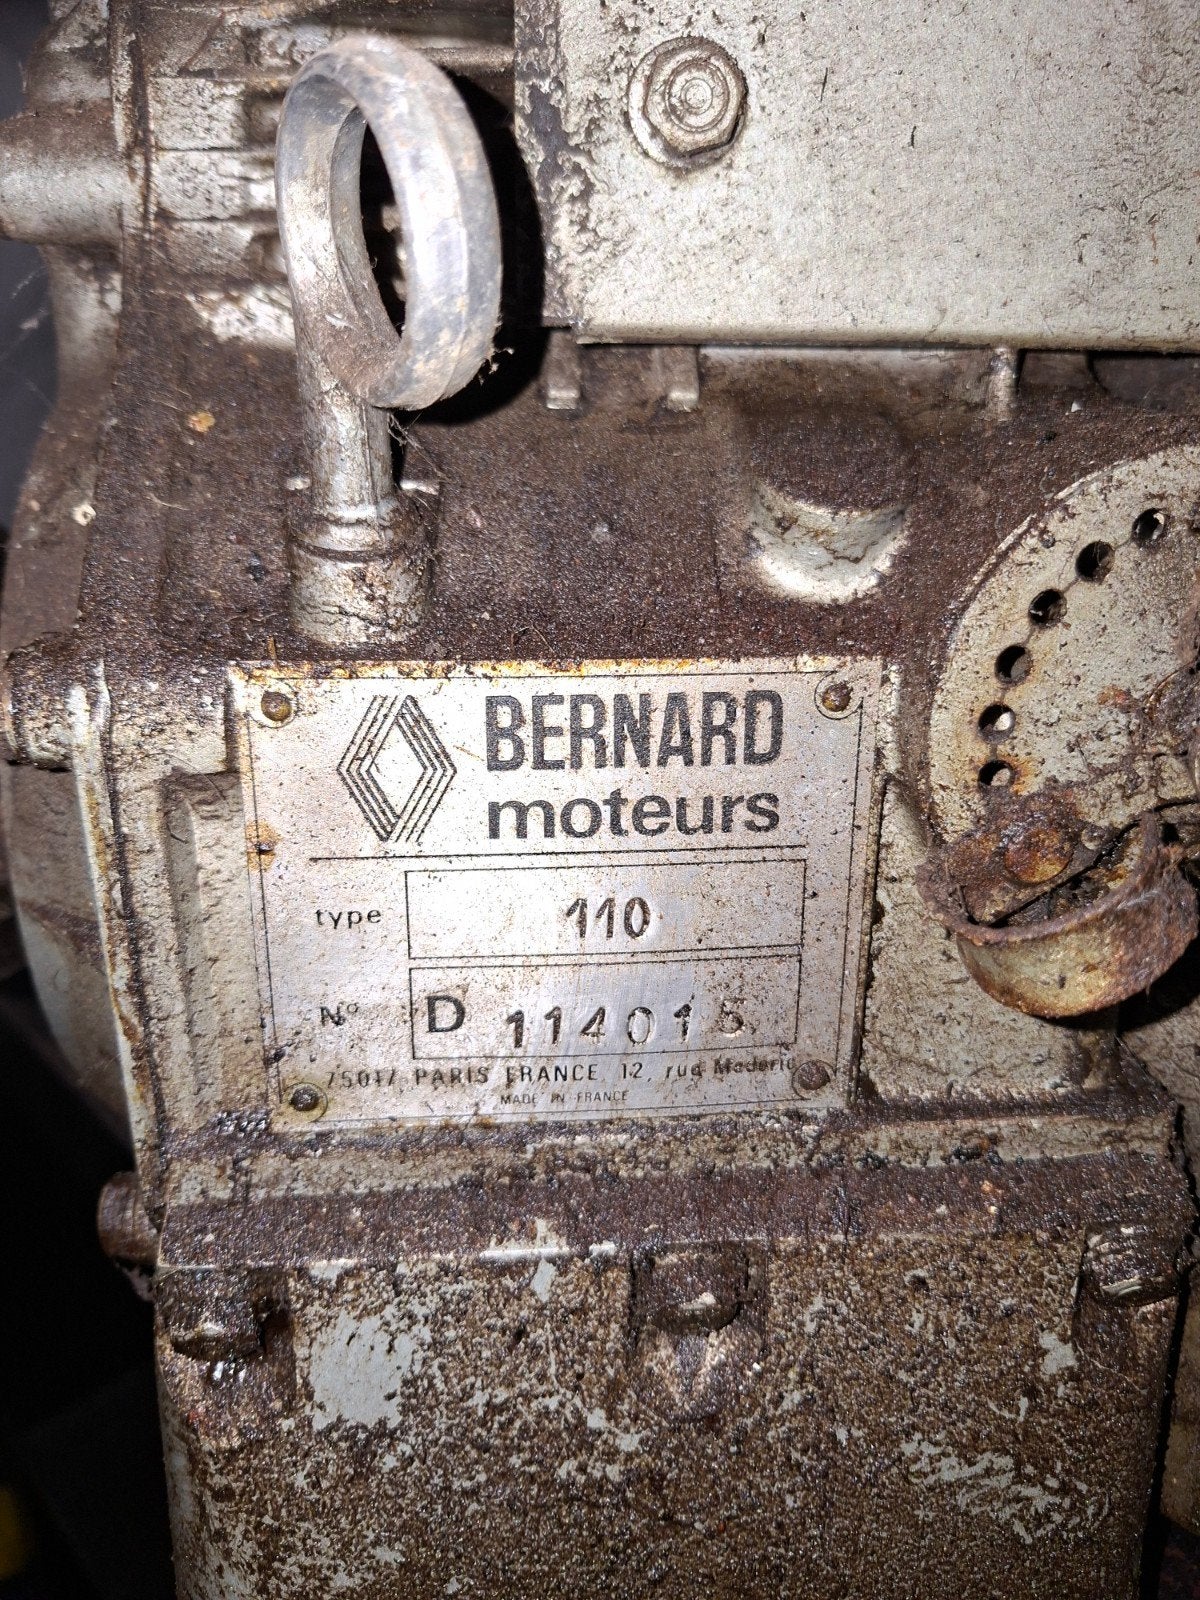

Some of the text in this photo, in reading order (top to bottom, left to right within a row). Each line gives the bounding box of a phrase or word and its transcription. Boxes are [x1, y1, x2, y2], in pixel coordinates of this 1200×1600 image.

[486, 690, 783, 771] BERNARD
[488, 788, 780, 839] moteurs
[315, 896, 650, 939] type 110
[426, 995, 466, 1033] D
[414, 1065, 490, 1085] PARIS
[506, 1063, 599, 1085] FRANCE
[621, 1061, 651, 1082] 12,
[665, 1062, 703, 1079] rue
[499, 1090, 629, 1105] MADE IN FRANCE
